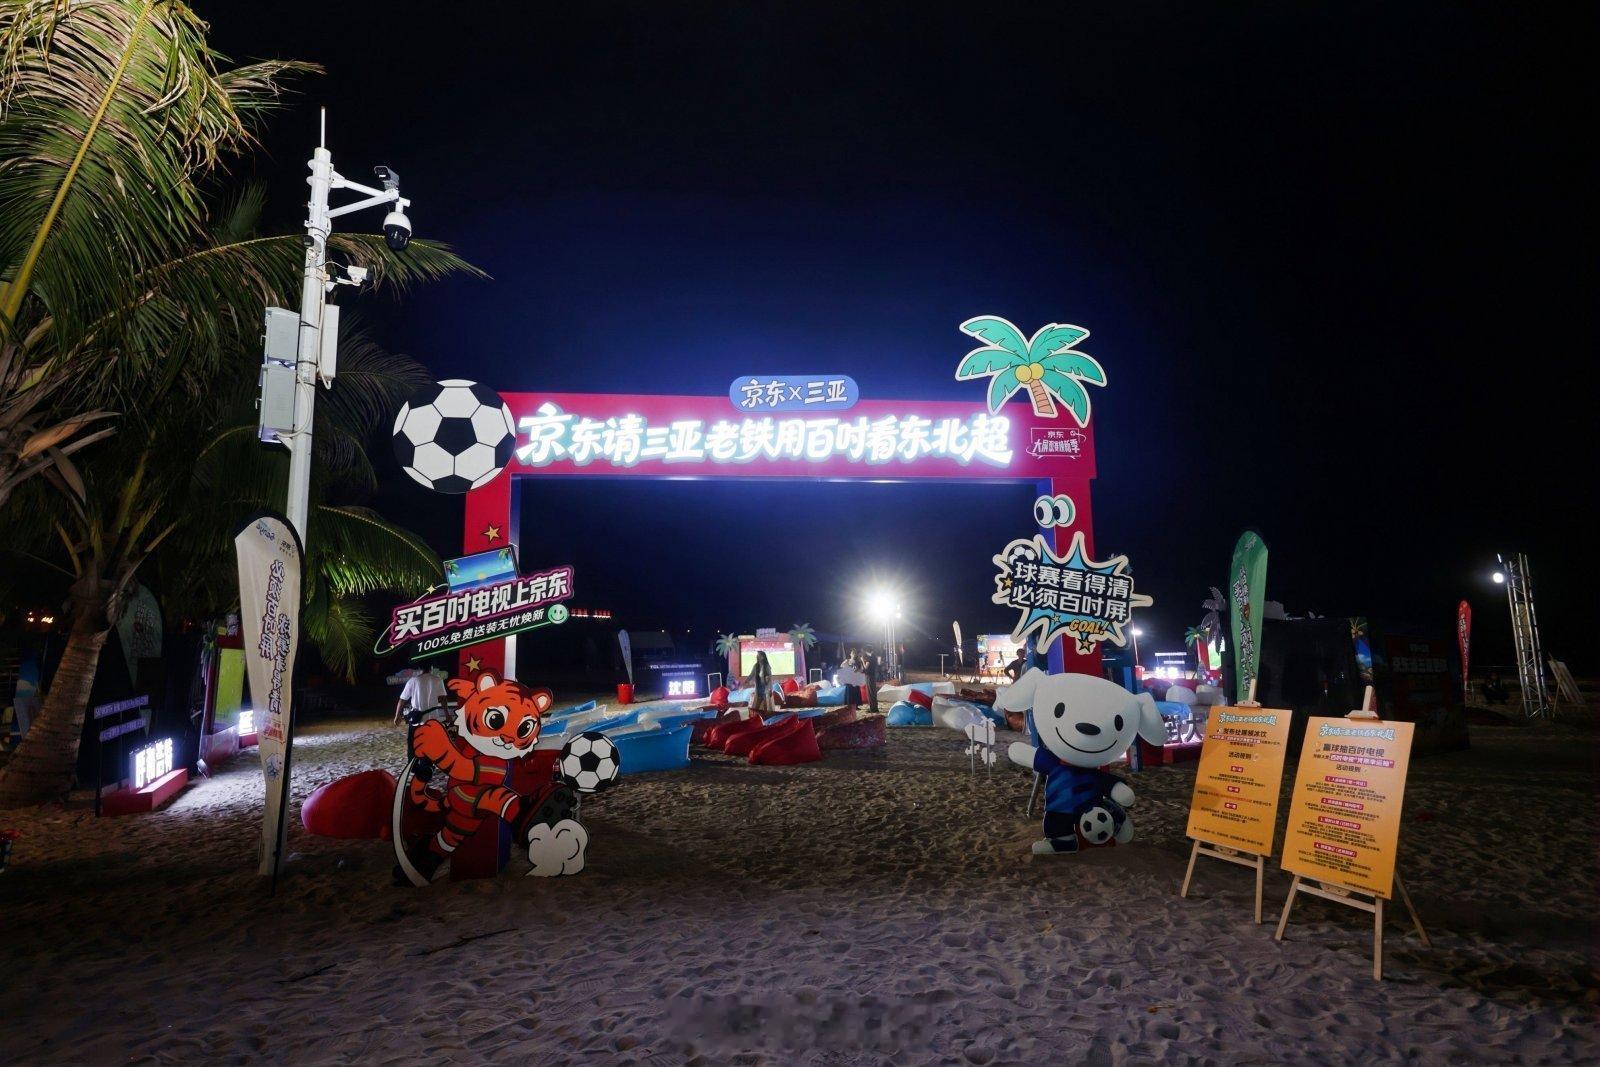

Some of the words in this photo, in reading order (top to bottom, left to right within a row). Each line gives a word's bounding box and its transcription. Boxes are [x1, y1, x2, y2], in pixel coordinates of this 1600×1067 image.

[1014, 561, 1130, 599] 球赛看得清
[394, 571, 568, 641] 买百吋电视上京东
[1012, 584, 1127, 621] 必须百吋屏
[417, 607, 545, 652] 100%免费送装无忧焕新
[1069, 619, 1109, 635] GOAL!
